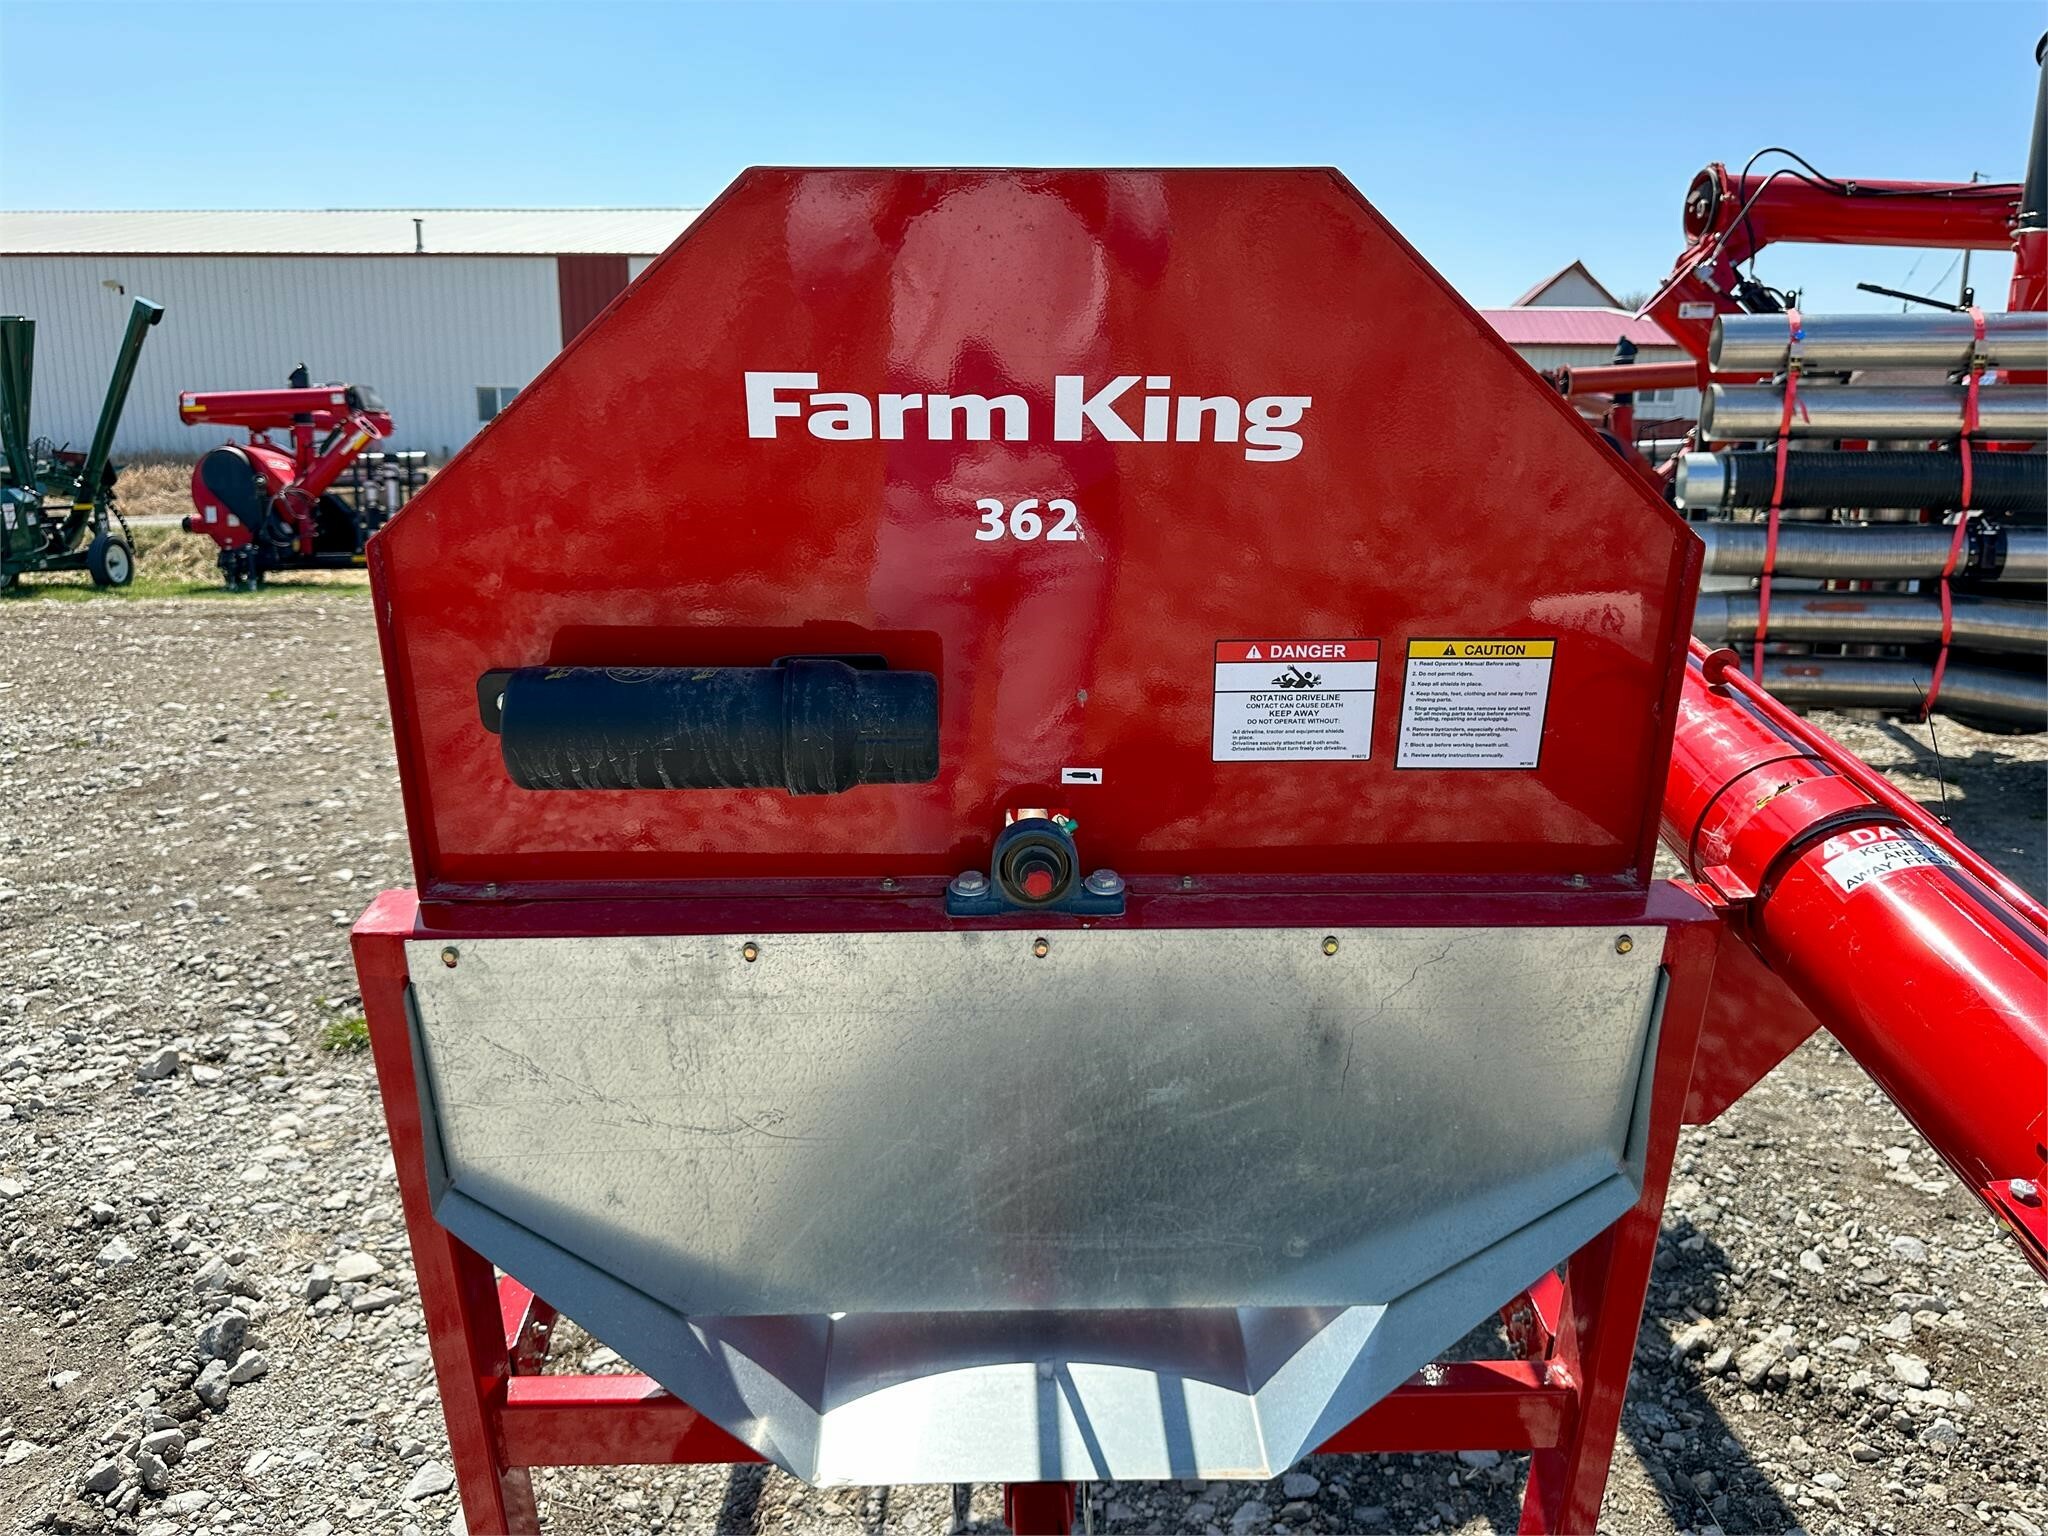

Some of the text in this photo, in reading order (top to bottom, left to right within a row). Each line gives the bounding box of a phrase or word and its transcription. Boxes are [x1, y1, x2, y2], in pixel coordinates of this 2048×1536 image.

[744, 371, 1312, 462] Farm King
[974, 499, 1078, 542] 362
[1270, 645, 1346, 658] DANGER
[1464, 645, 1526, 655] CAUTION
[1859, 842, 1907, 856] KEEP
[1884, 849, 1921, 860] AND
